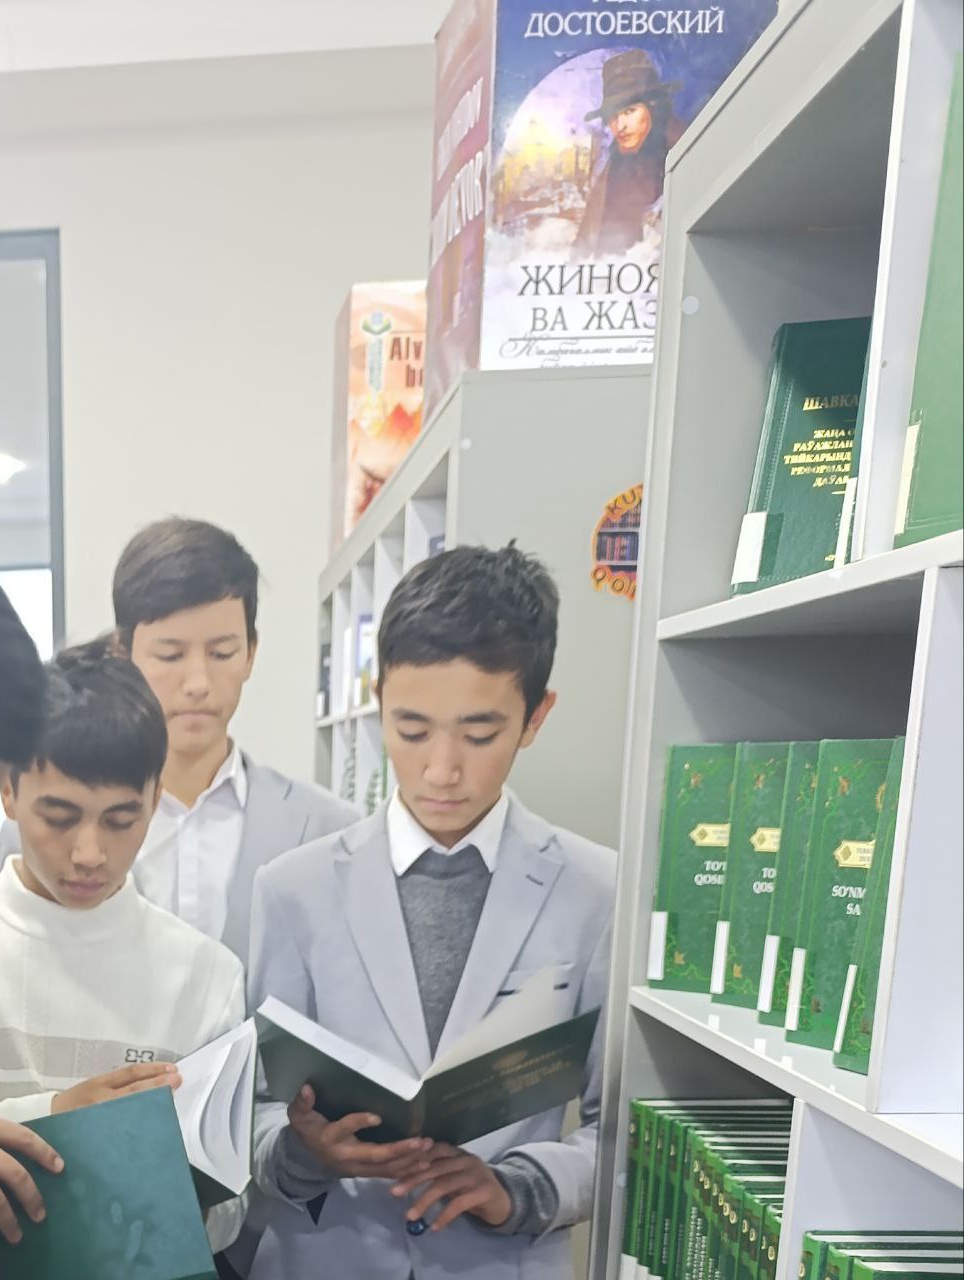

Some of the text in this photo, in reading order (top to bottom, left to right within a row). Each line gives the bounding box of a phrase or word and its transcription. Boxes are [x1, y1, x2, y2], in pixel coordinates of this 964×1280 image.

[524, 6, 725, 38] ДОСТОЕВСКИЙ
[517, 262, 659, 297] ЖИНОЯ
[530, 306, 568, 332] ВА
[606, 484, 643, 515] KU
